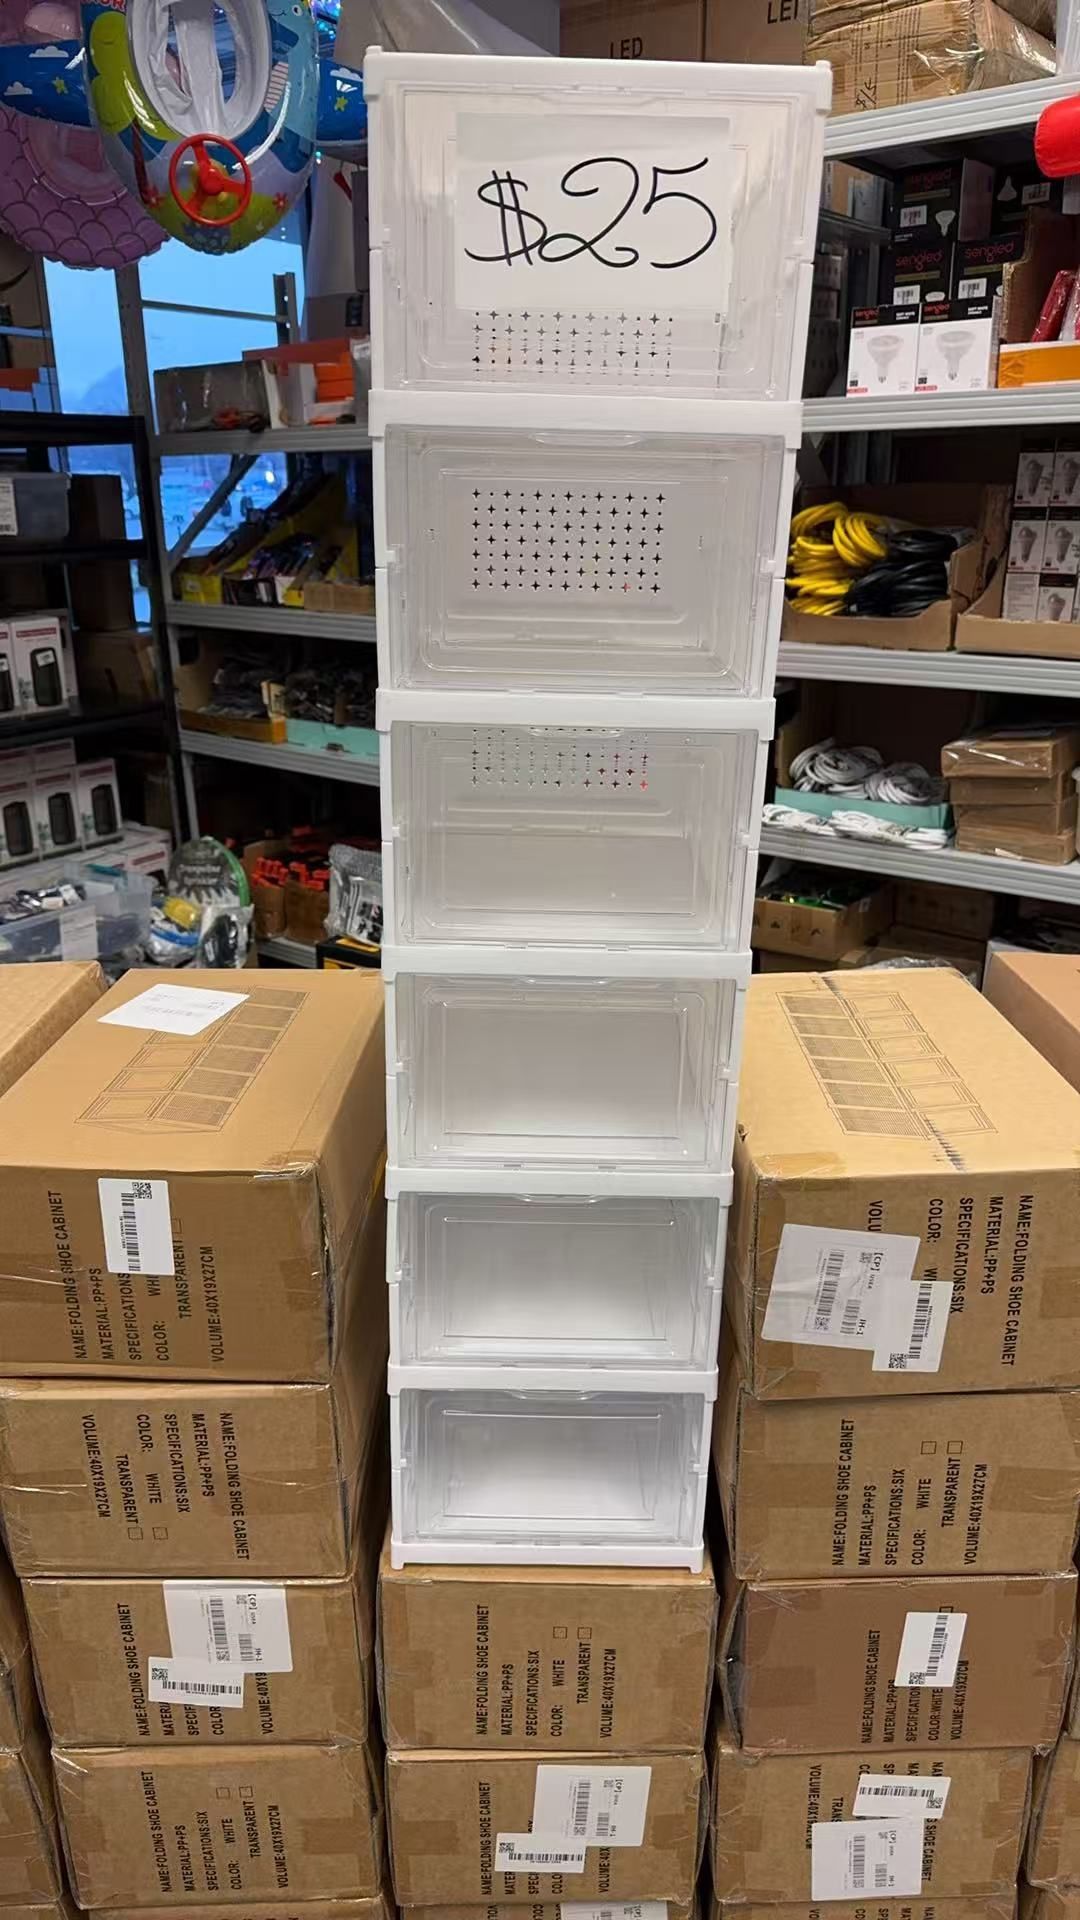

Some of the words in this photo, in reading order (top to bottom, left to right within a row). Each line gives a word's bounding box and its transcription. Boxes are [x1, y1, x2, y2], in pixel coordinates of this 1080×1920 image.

[464, 157, 717, 268] $25
[896, 251, 943, 270] sengled
[964, 242, 1015, 263] sengled
[48, 1191, 68, 1240] CABINET
[926, 1199, 943, 1243] COLOR:
[1012, 1195, 1034, 1282] NAME:FOLDING
[58, 1243, 73, 1276] SHOE
[950, 1197, 974, 1314] SPECIFICATIONS:SIX
[981, 1196, 1003, 1294] MATERIAL:PP+PS
[173, 1238, 192, 1319] TRANSPARENT
[200, 1246, 225, 1363] VOLUME:40X19X27CM
[1007, 1286, 1023, 1316] SHOE
[63, 1277, 88, 1359] NAME:FOLDING
[89, 1267, 115, 1360] MATERIAL:PP+PS
[155, 1320, 169, 1361] COLOR:
[1002, 1320, 1019, 1366] CABINET
[82, 1414, 111, 1518] VOLUME:40X19X27CM
[136, 1414, 154, 1452] COLOR:
[146, 1473, 162, 1504] WHITE
[164, 1414, 191, 1513] SPECIFICATIONS:SIX
[192, 1413, 215, 1498] MATERIAL:PP+PS
[220, 1412, 240, 1488] NAME:FOLDING
[839, 1419, 854, 1462] CABINET
[116, 1454, 139, 1524] TRANSPARENT
[229, 1490, 245, 1517] SHOE
[837, 1464, 851, 1491] SHOE
[916, 1478, 932, 1509] WHITE
[941, 1457, 961, 1528] TRANSPARENT
[233, 1519, 250, 1560] CABINET
[832, 1494, 849, 1566] NAME:FOLDING
[859, 1485, 877, 1566] MATERIAL:PP+PS
[885, 1469, 905, 1566] SPECIFICATIONS:SIX
[964, 1464, 987, 1565] VOLUME:40X19X27CM
[911, 1529, 926, 1565] COLOR:
[117, 1603, 135, 1643] CABINET
[476, 1604, 489, 1643] CABINET
[867, 1630, 880, 1663] CABINET
[124, 1645, 140, 1670] SHOE
[476, 1645, 489, 1669] SHOE
[552, 1659, 565, 1687] WHITE
[577, 1642, 592, 1704] TRANSPARENT
[864, 1665, 877, 1687] SHOE
[128, 1671, 151, 1736] NAME:FOLDING
[476, 1670, 489, 1735] NAME:FOLDING
[501, 1663, 514, 1736] MATERIAL:PP+PS
[525, 1650, 540, 1737] SPECIFICATIONS:SIX
[550, 1704, 564, 1737] COLOR:
[600, 1648, 616, 1738] VOLUME:40X19X27CM
[861, 1687, 876, 1743] NAME:FOLDING
[141, 1771, 158, 1807] CABINET
[479, 1782, 491, 1815] CABINET
[148, 1809, 162, 1831] SHOE
[221, 1818, 236, 1844] WHITE
[243, 1801, 261, 1858] TRANSPARENT
[267, 1805, 288, 1888] VOLUME:40X19X27CM
[480, 1816, 492, 1838] SHOE
[923, 1824, 937, 1847] SHOE
[152, 1833, 172, 1892] NAME:FOLDING
[175, 1824, 196, 1892] MATERIAL:PP+PS
[196, 1811, 219, 1891] SPECIFICATIONS:SIX
[228, 1860, 242, 1890] COLOR:
[479, 1839, 493, 1895] NAME:FOLDING
[921, 1849, 935, 1881] CABINET
